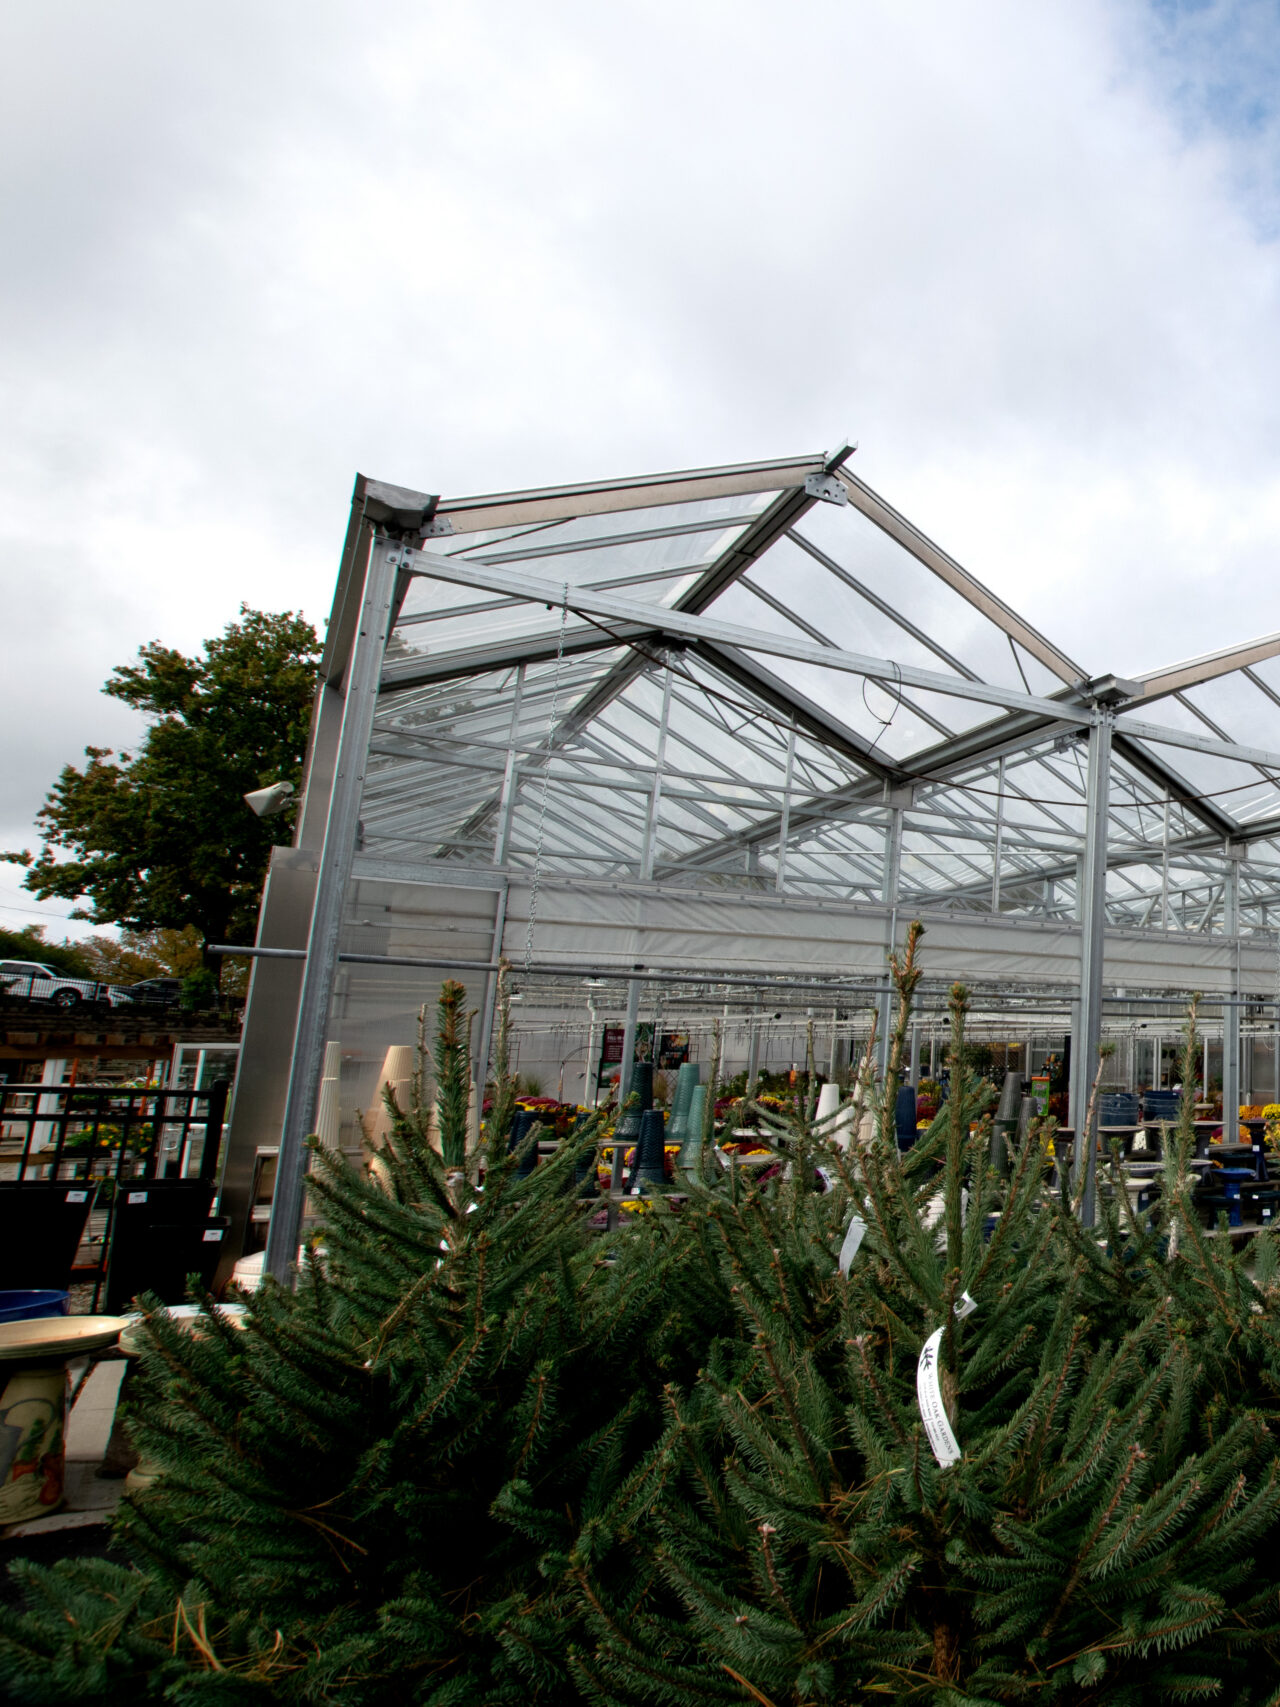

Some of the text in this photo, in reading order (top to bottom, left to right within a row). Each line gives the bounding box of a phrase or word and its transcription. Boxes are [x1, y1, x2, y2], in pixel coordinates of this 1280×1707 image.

[927, 1371, 936, 1399] WHITE
[931, 1399, 941, 1419] OAK
[937, 1419, 955, 1455] GARDENS
